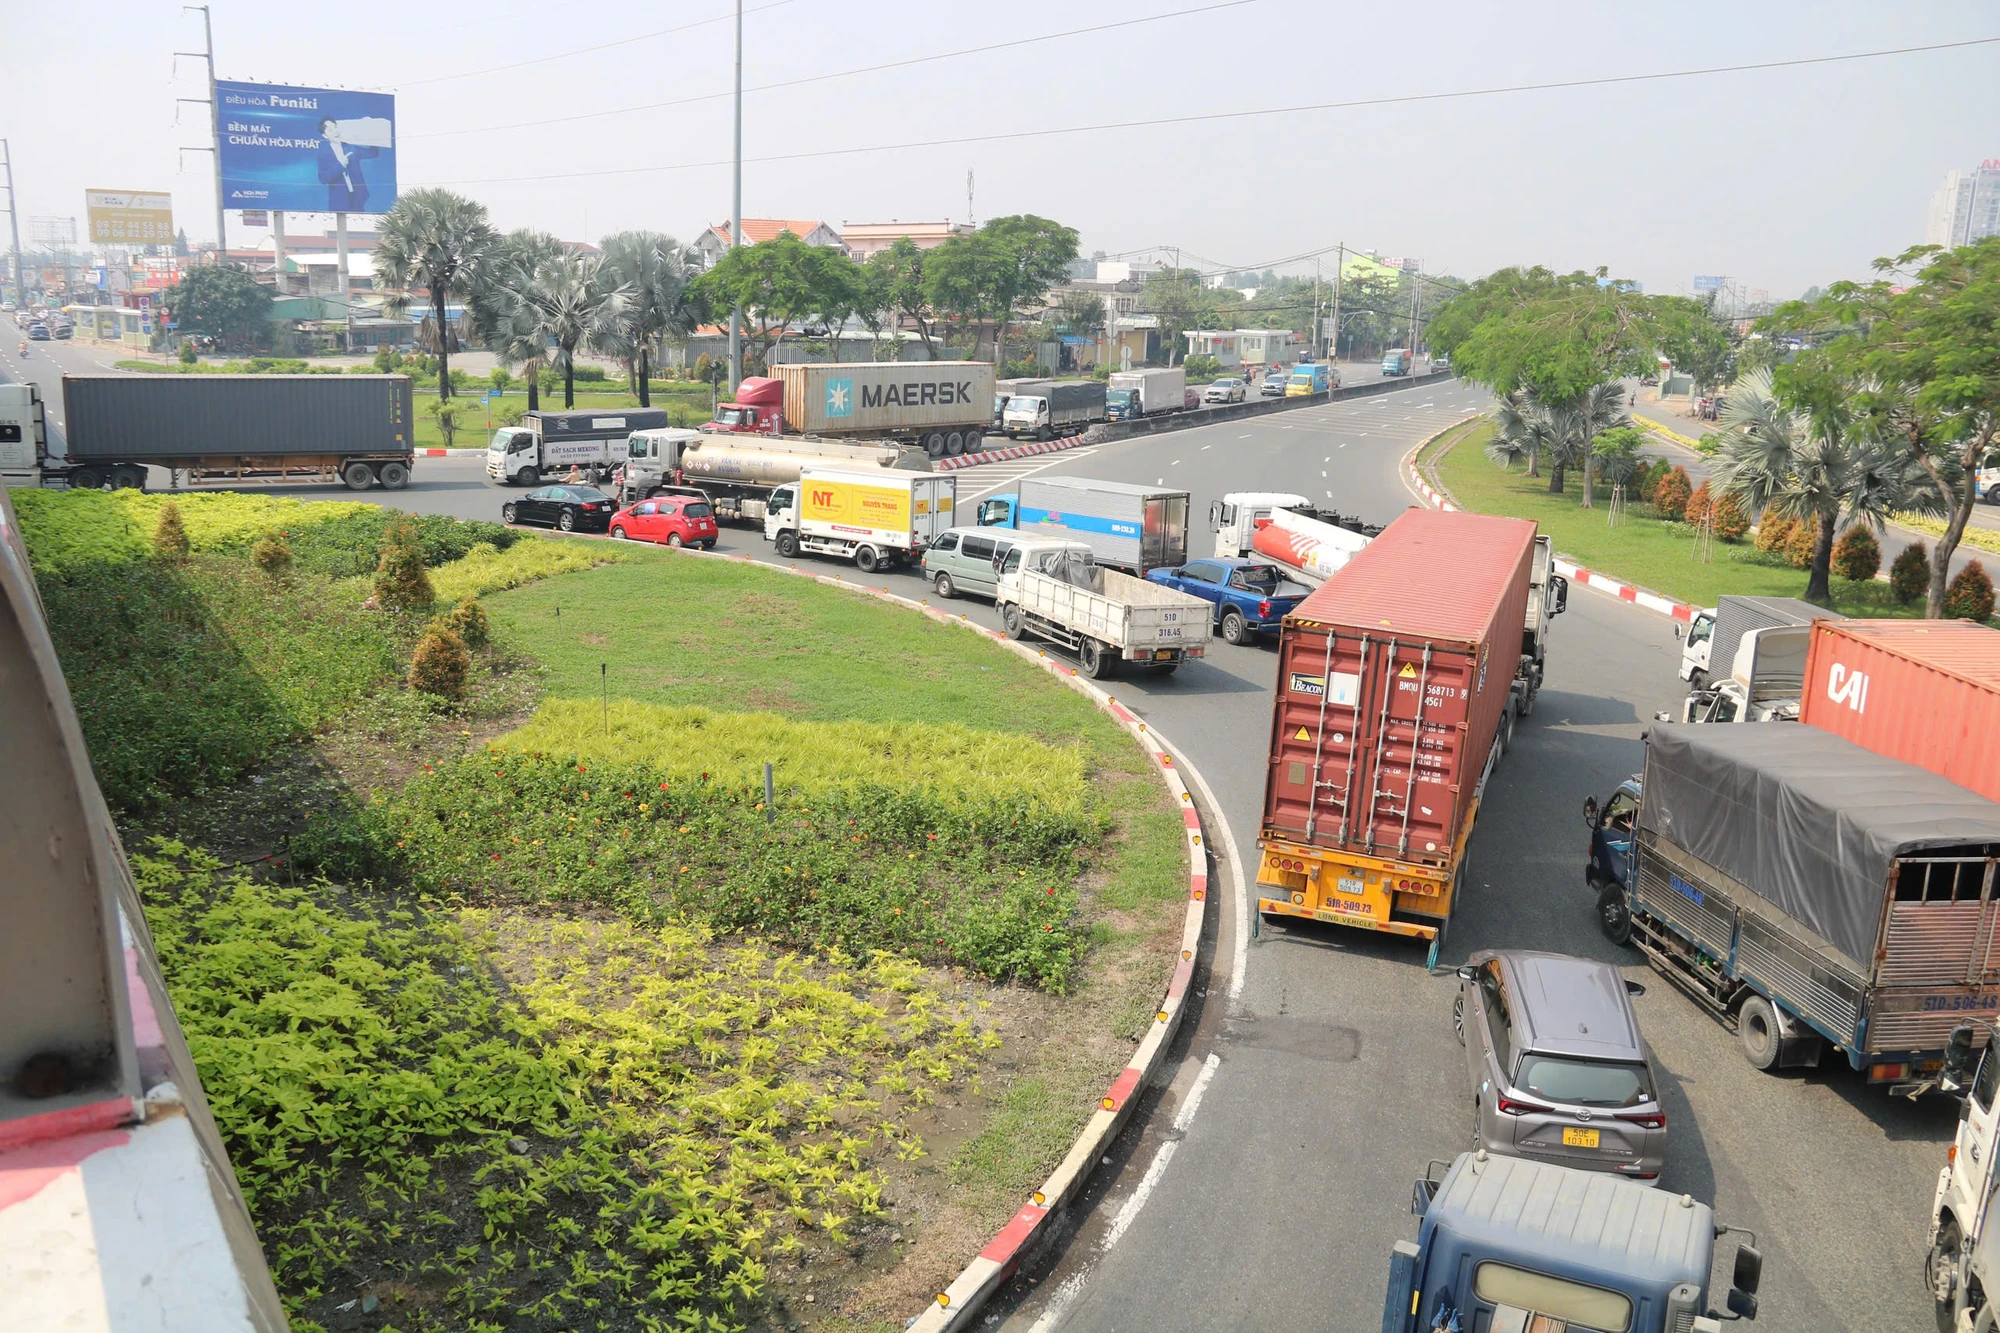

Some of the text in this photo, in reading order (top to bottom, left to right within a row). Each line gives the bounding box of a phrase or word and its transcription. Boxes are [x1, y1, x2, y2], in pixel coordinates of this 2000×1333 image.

[225, 95, 318, 109] ĐIỀU HÒA Funiki
[228, 121, 271, 133] BỀN MÁT
[229, 134, 320, 149] CHUẨN HÒA PHÁT
[862, 381, 971, 408] MAERSK
[813, 490, 835, 507] NT
[1164, 613, 1177, 621] 51D
[1158, 628, 1181, 637] 316.45
[1295, 680, 1324, 694] BEACON
[1399, 681, 1468, 699] BMOU 568713 9
[1827, 662, 1870, 714] CAI
[1424, 696, 1443, 707] 45G1
[1326, 897, 1372, 913] 51R-509.73
[1342, 917, 1373, 928] VEHICLE
[1573, 1128, 1589, 1138] 50E
[1567, 1137, 1595, 1146] 103.10
